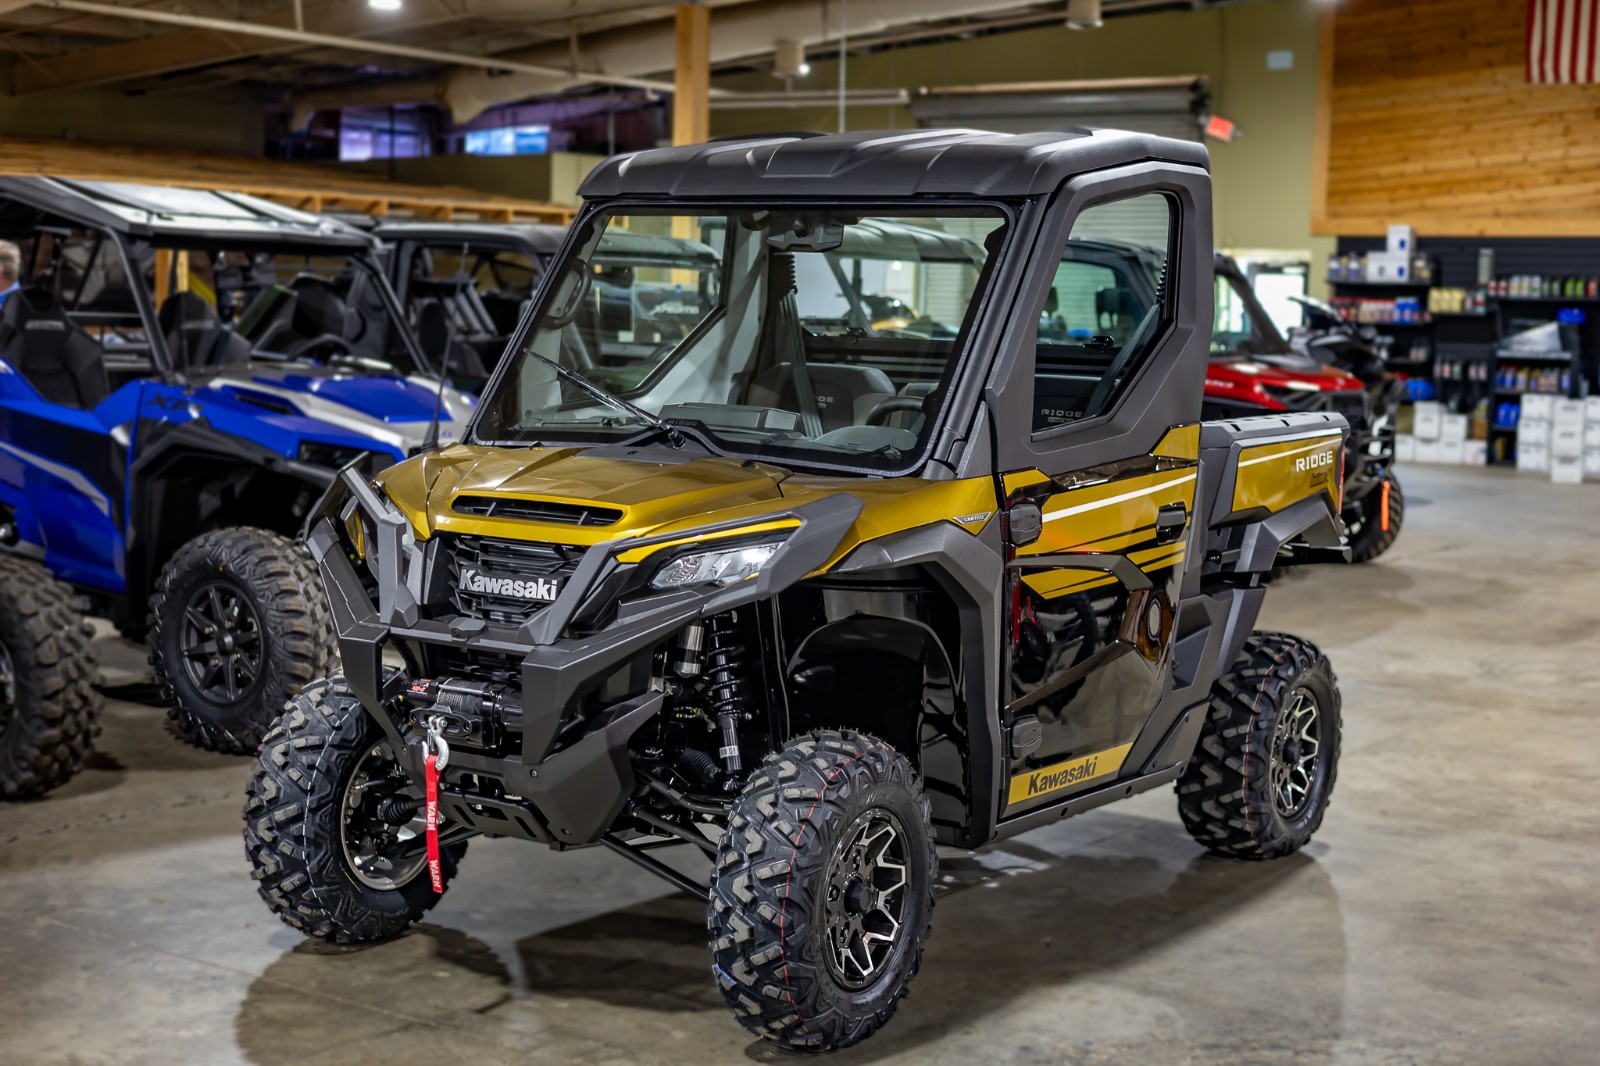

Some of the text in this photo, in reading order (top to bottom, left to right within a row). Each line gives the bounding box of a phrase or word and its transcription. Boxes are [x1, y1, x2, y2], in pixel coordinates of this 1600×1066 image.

[1041, 409, 1083, 418] RIDGE
[1295, 450, 1334, 472] RIDGE
[459, 569, 558, 601] Kawasaki
[1027, 756, 1098, 796] Kawasaki
[427, 801, 436, 831] WARN
[429, 860, 440, 888] WARN
